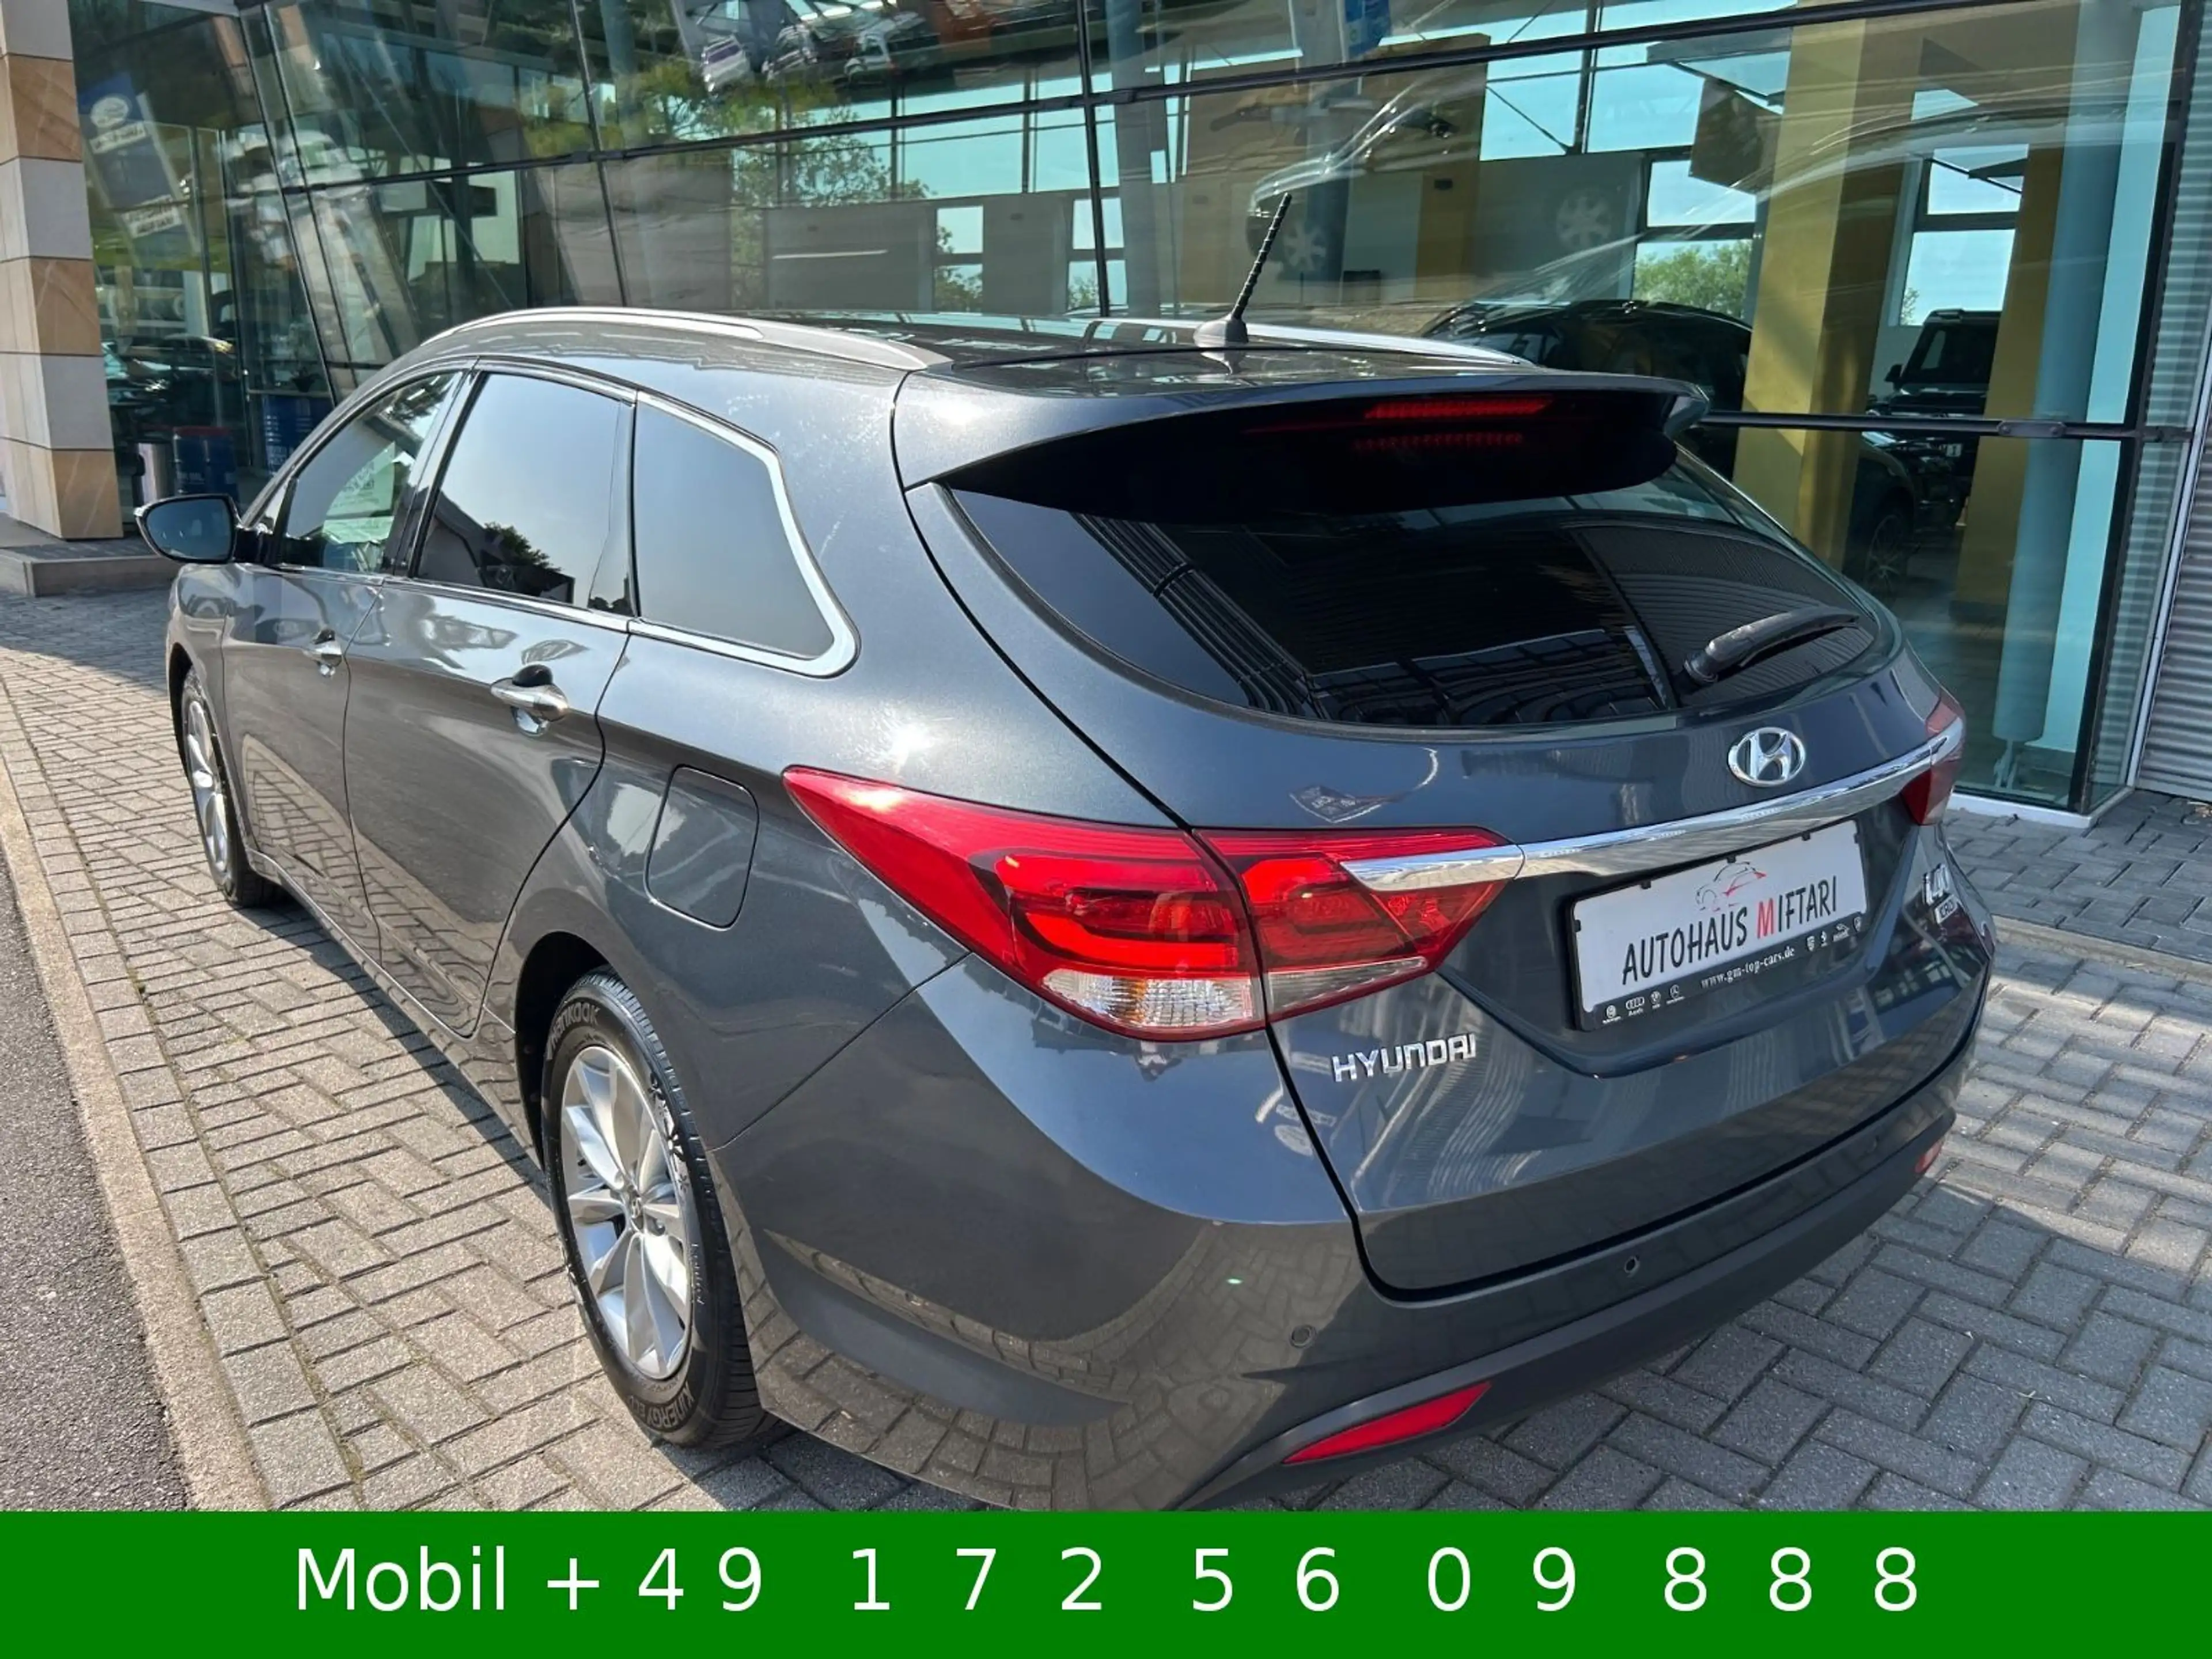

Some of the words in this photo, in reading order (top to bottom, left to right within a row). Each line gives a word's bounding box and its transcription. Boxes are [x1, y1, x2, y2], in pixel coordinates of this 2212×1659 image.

[1622, 907, 1748, 986] AUTOHAUS
[1756, 875, 1837, 940] MIFTARI
[1700, 946, 1796, 989] www.gm-top-cars.de
[1332, 1033, 1476, 1082] HYUNDAI
